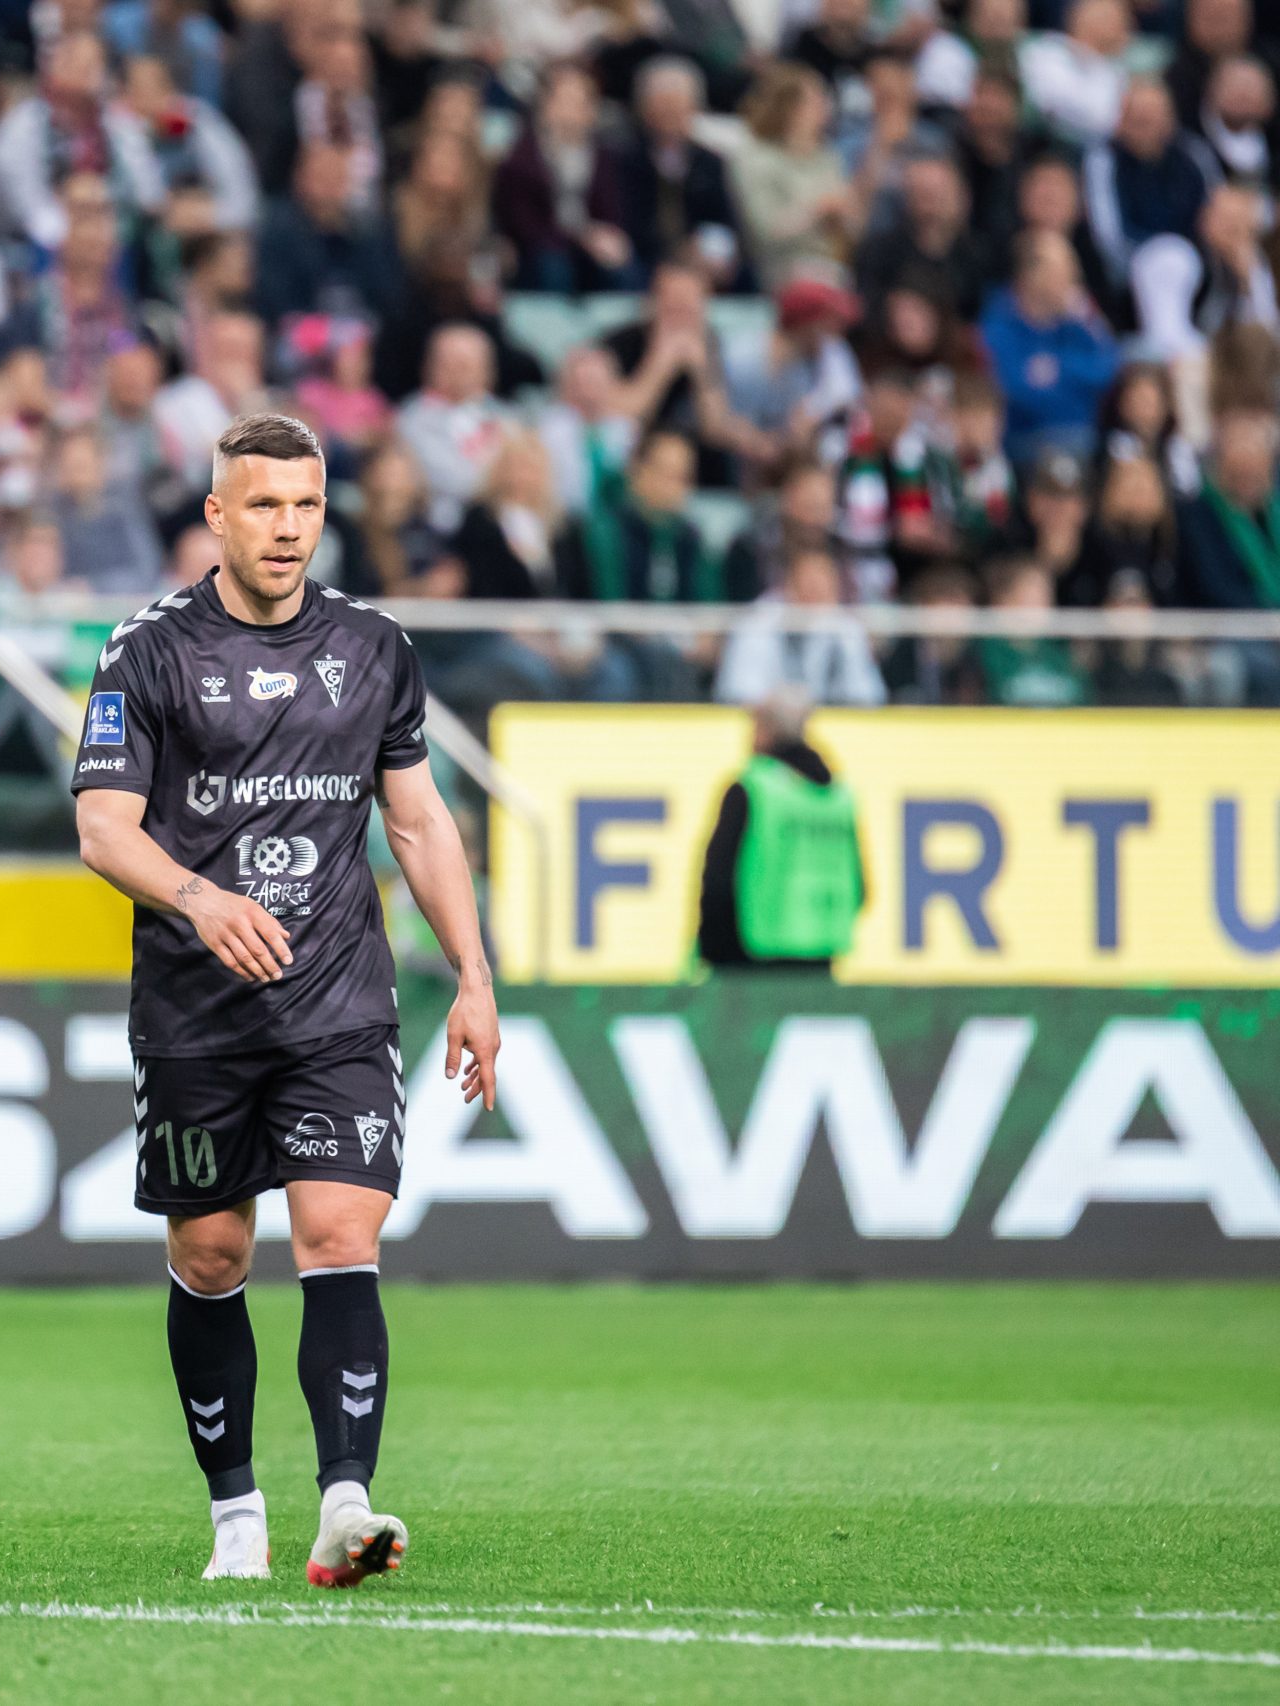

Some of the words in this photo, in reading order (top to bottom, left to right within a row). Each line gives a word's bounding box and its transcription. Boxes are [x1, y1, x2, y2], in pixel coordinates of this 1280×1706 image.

[259, 678, 287, 694] LOTTO
[574, 794, 1280, 957] FRTU
[154, 1121, 218, 1188] 10
[289, 1139, 339, 1157] ZARYS
